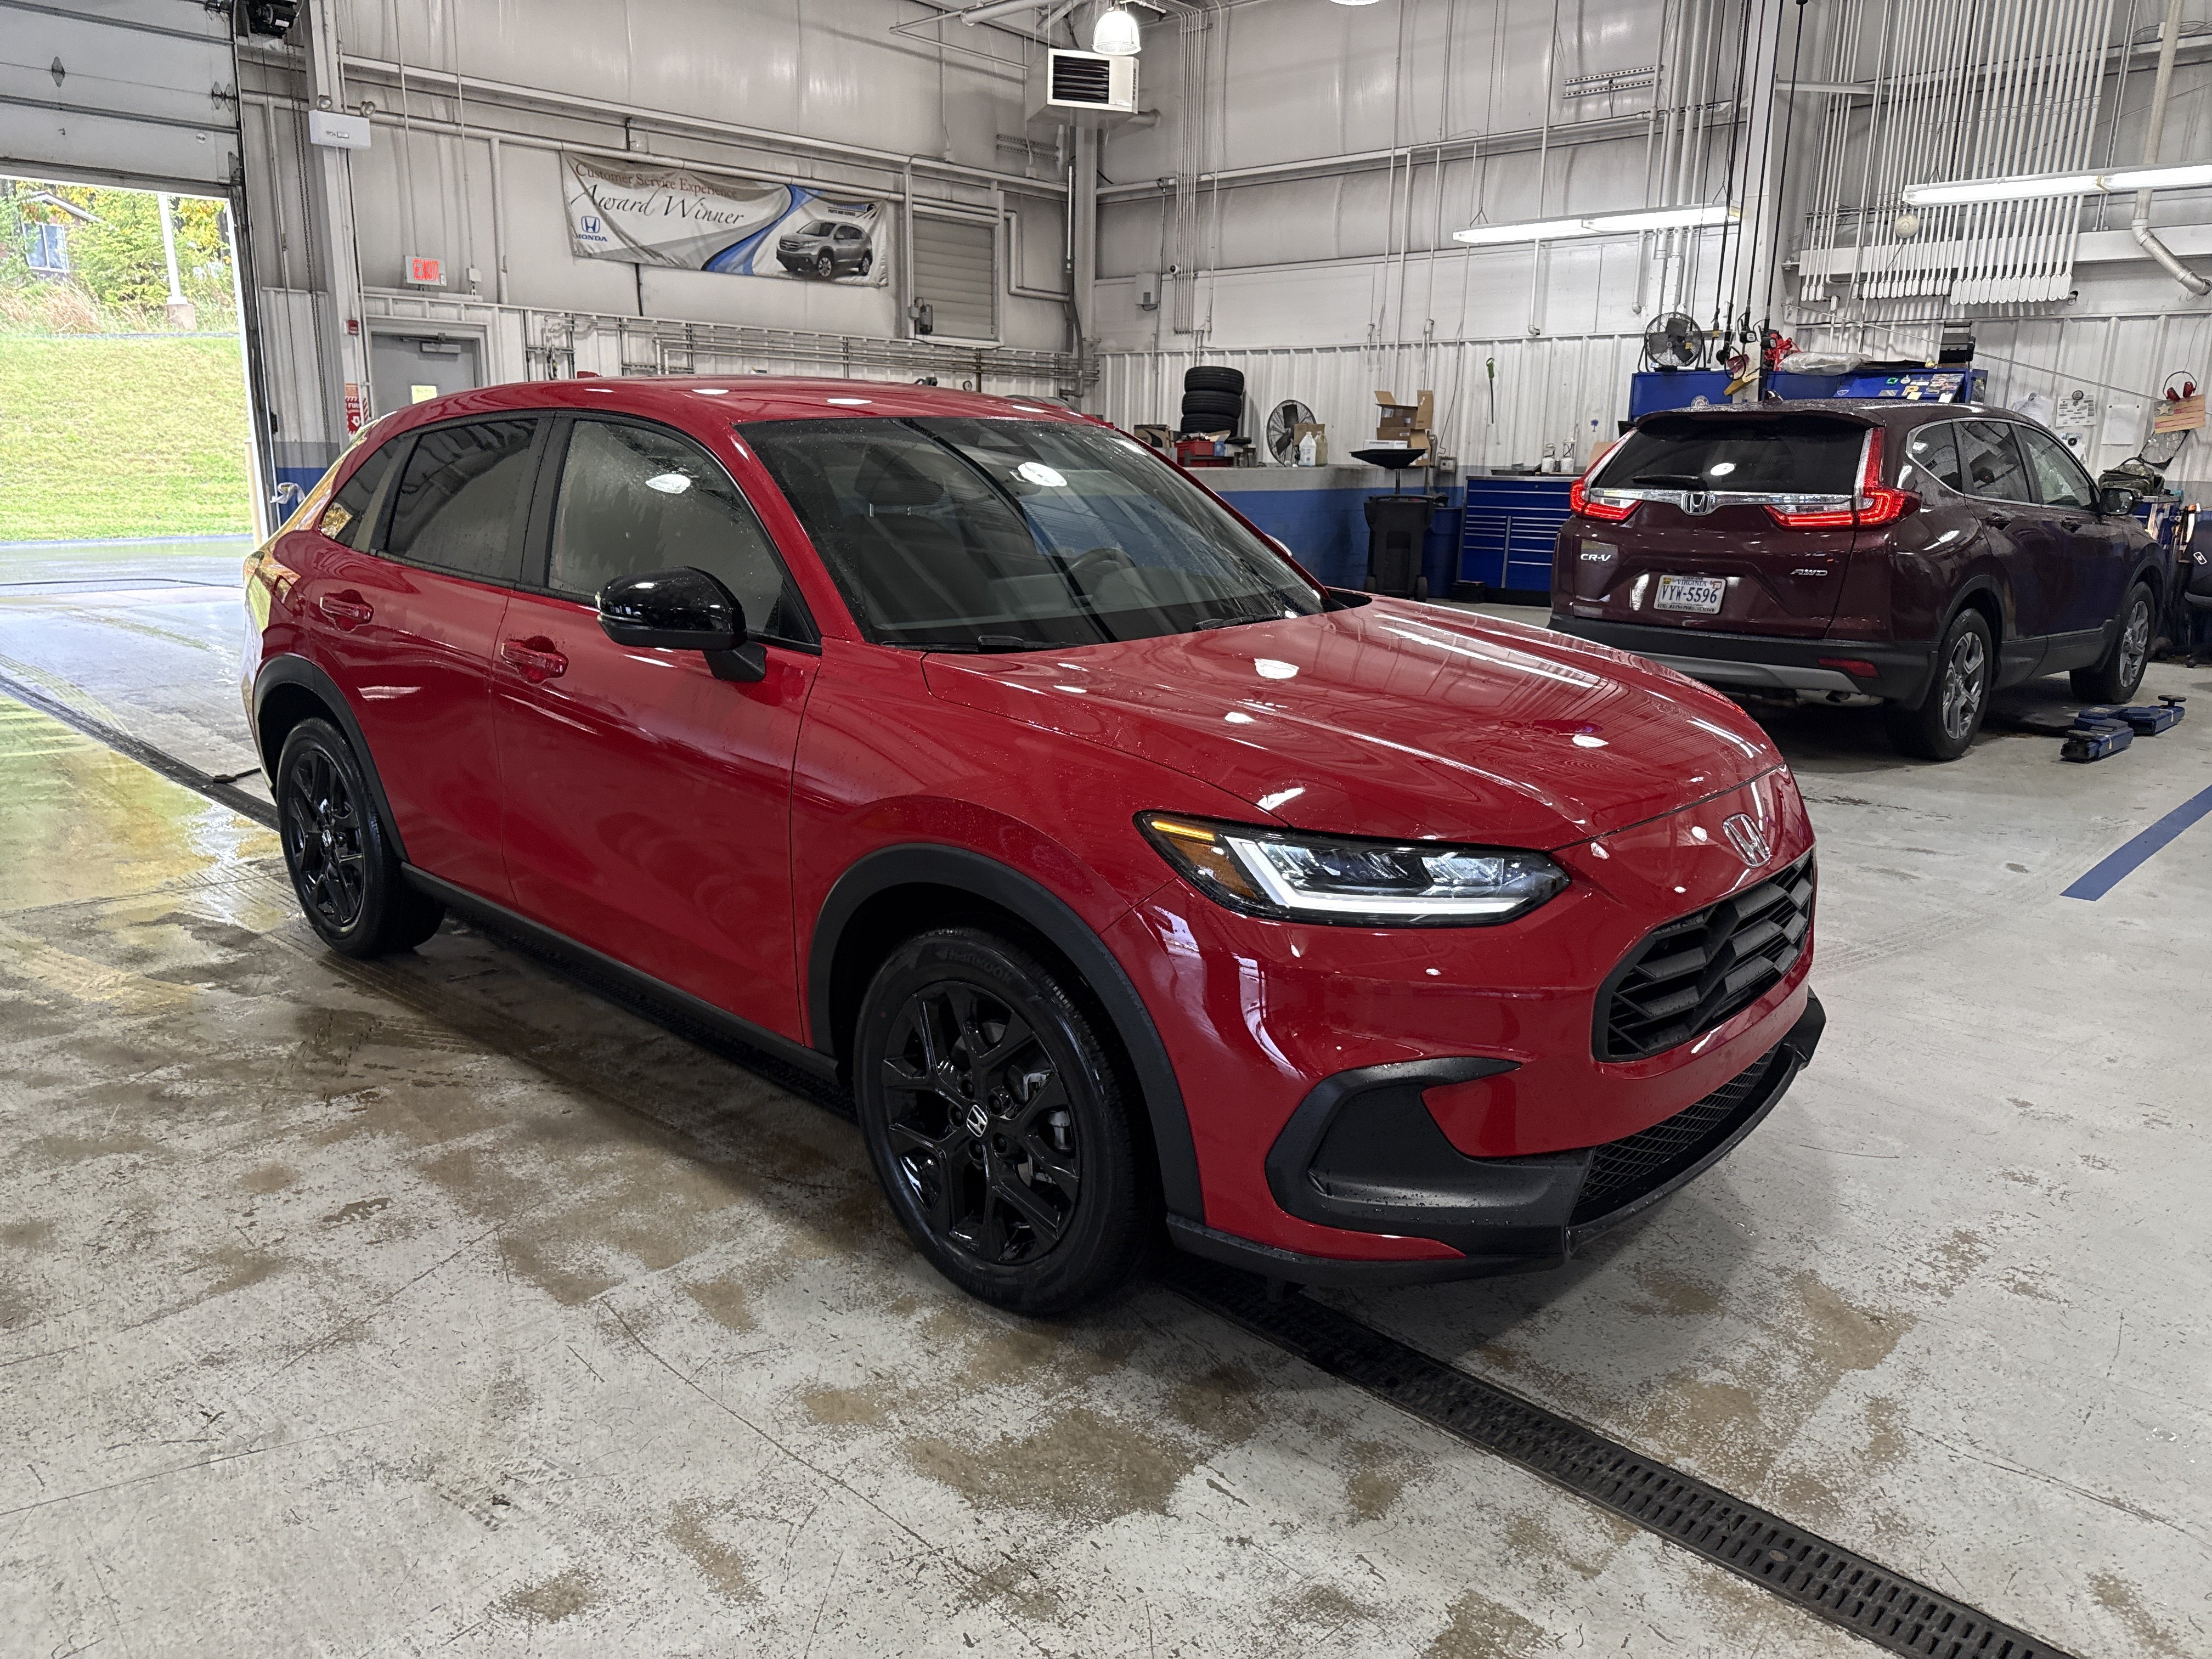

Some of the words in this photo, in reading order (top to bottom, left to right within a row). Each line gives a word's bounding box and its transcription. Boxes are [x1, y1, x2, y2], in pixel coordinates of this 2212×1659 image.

[576, 163, 633, 184] Customer
[636, 173, 675, 189] Service
[680, 178, 738, 198] Experience
[571, 184, 666, 216] Award
[664, 195, 744, 224] Winner
[576, 234, 607, 242] HONDA
[413, 258, 439, 281] EXIT
[1581, 554, 1611, 562] CR-V
[1662, 585, 1719, 603] VYW-5596
